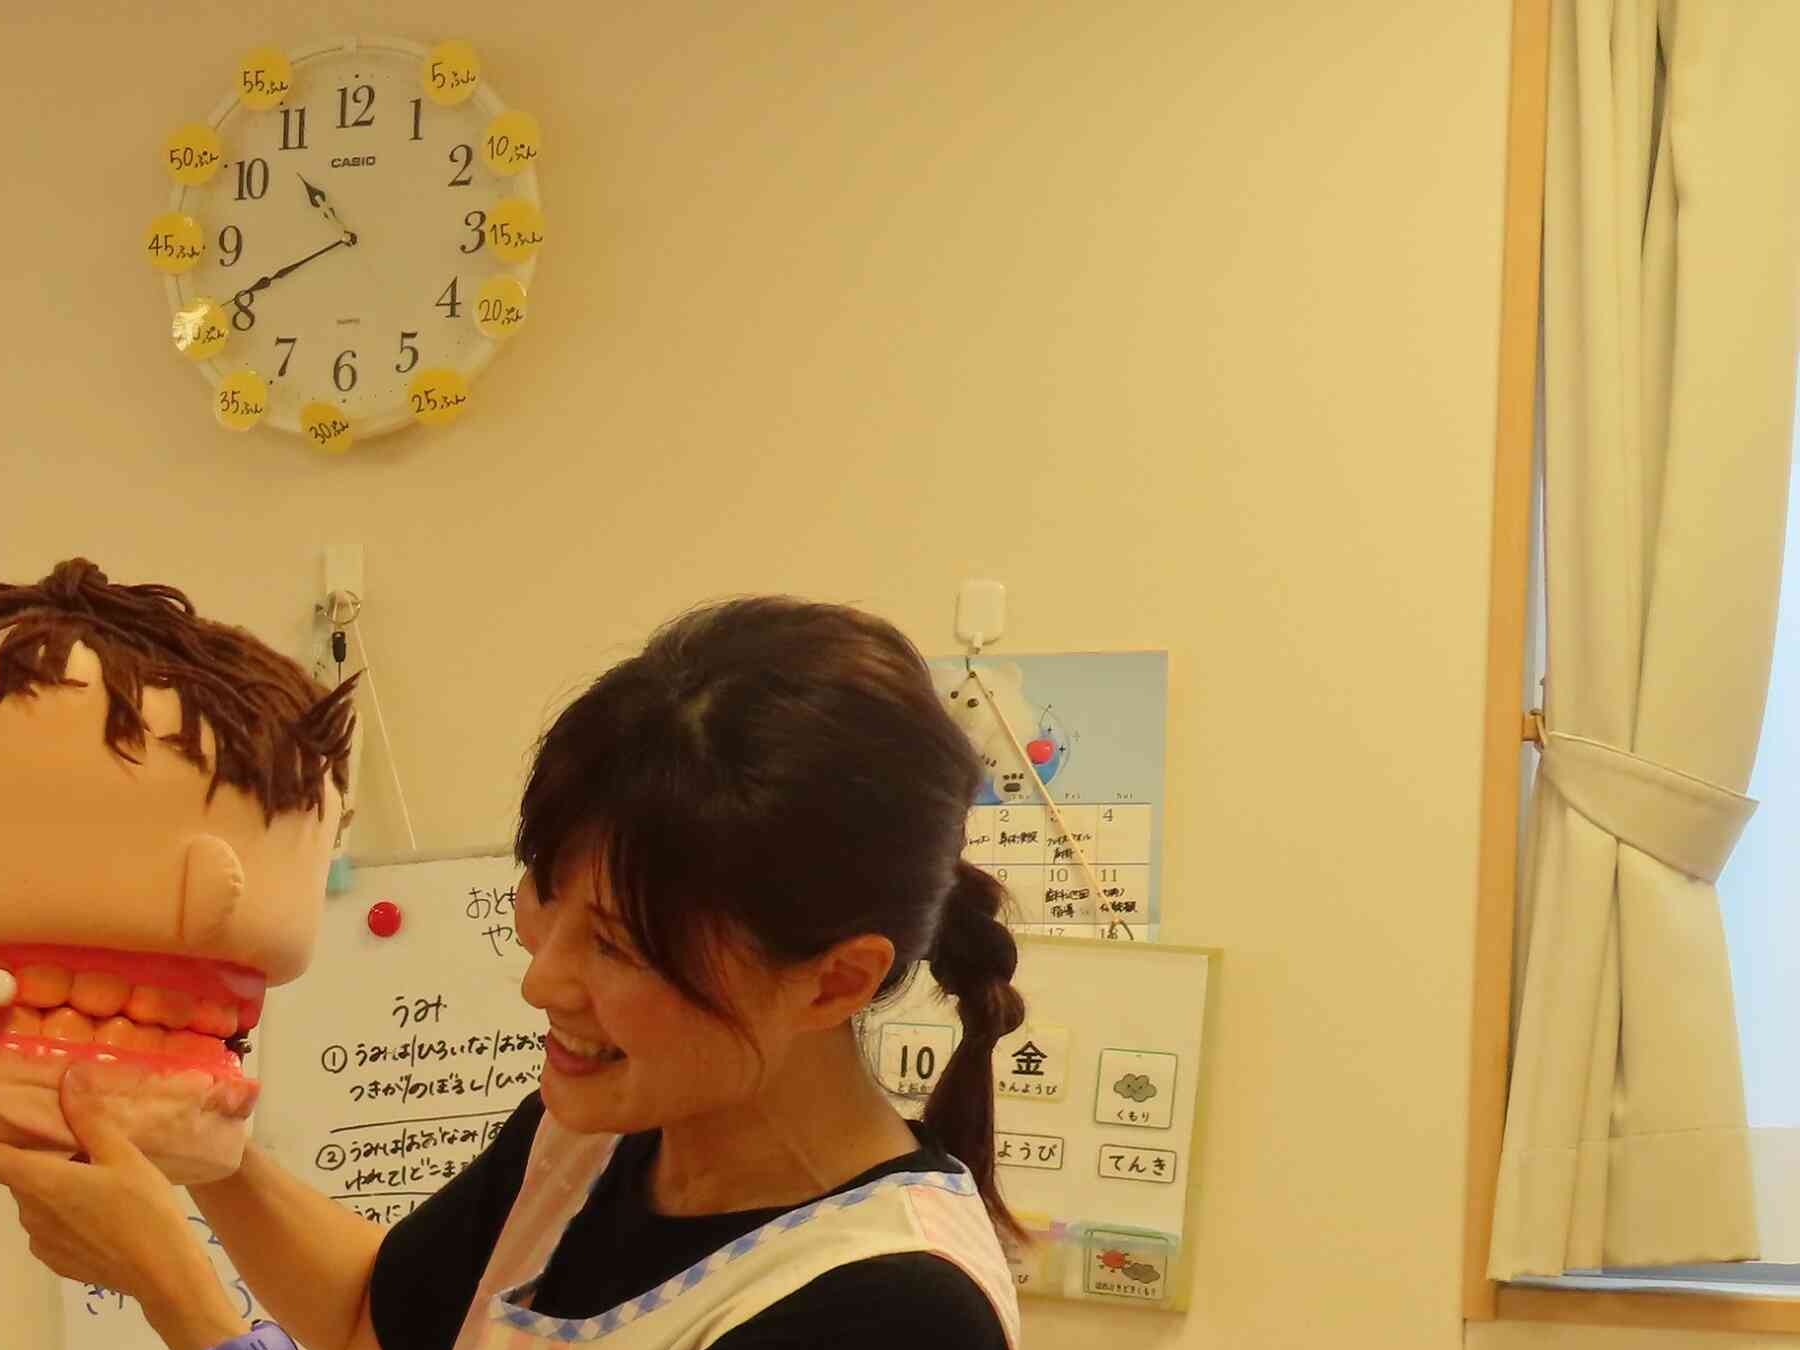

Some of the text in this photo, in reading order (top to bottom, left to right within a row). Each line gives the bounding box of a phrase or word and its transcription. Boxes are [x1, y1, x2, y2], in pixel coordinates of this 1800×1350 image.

[335, 84, 376, 129] 12
[409, 98, 425, 141] 1
[277, 104, 309, 151] 11
[233, 157, 270, 201] 10
[330, 155, 377, 169] CASIO
[447, 144, 474, 188] 2
[217, 225, 244, 268] 9
[459, 210, 487, 254] 3
[231, 289, 256, 331] 8
[435, 275, 463, 319] 4
[274, 337, 297, 378] 7
[332, 350, 359, 392] 6
[395, 331, 420, 373] 5
[999, 808, 1009, 823] 2
[1102, 808, 1114, 822] 4
[1048, 868, 1069, 882] 10
[1100, 868, 1118, 882] 11
[392, 995, 448, 1028] うみ
[900, 1045, 935, 1080] 10
[1011, 1040, 1048, 1076] 金
[999, 1081, 1058, 1095] きんようび
[1115, 1108, 1151, 1123] くもり
[997, 1140, 1058, 1162] ようび
[1108, 1154, 1167, 1176] てんき
